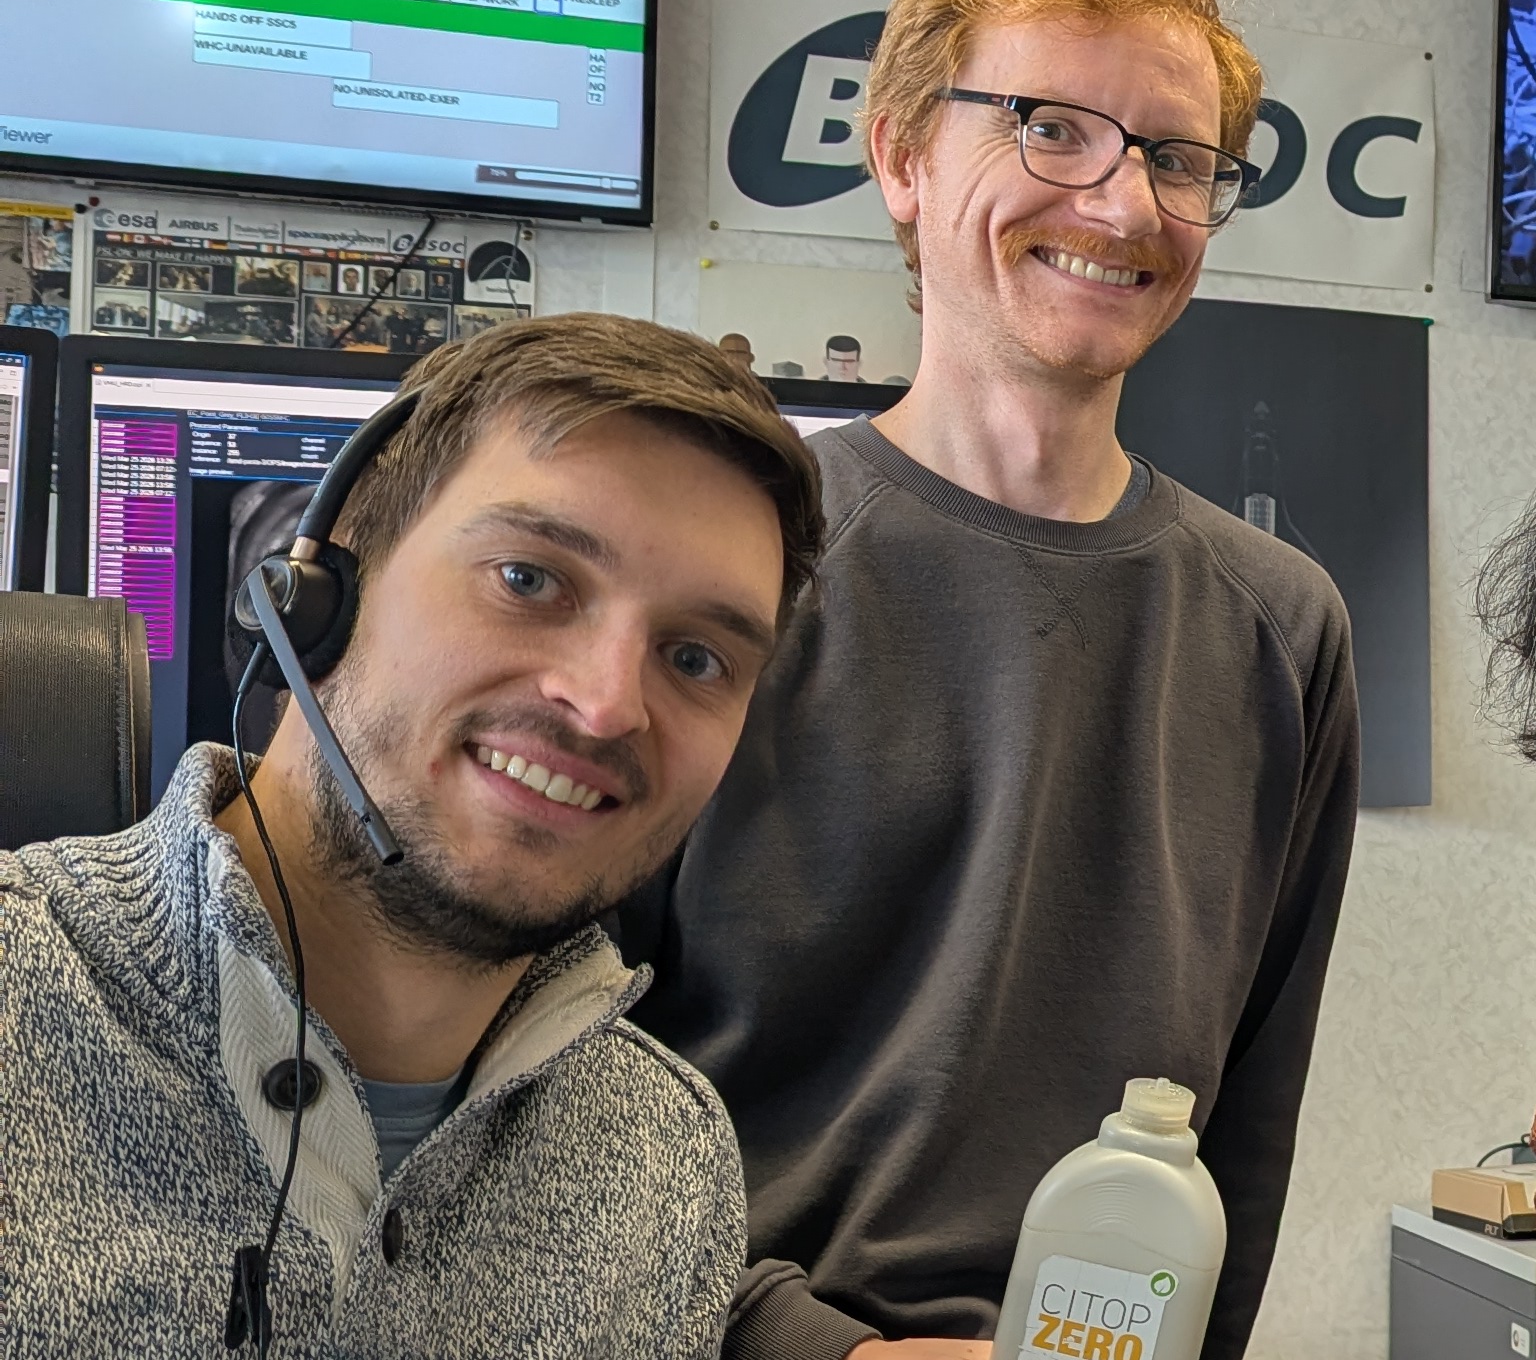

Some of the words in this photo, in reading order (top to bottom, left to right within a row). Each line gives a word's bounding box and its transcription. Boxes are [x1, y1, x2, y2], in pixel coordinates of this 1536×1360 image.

[195, 7, 238, 24] HANDS
[240, 13, 264, 27] OFF
[194, 37, 309, 62] WHC-UNAVAILABLE
[333, 82, 460, 106] NO-UNISOLATED-EXER
[117, 212, 157, 230] esa
[168, 219, 219, 232] AIRBUS
[1041, 1283, 1152, 1332] CITOP
